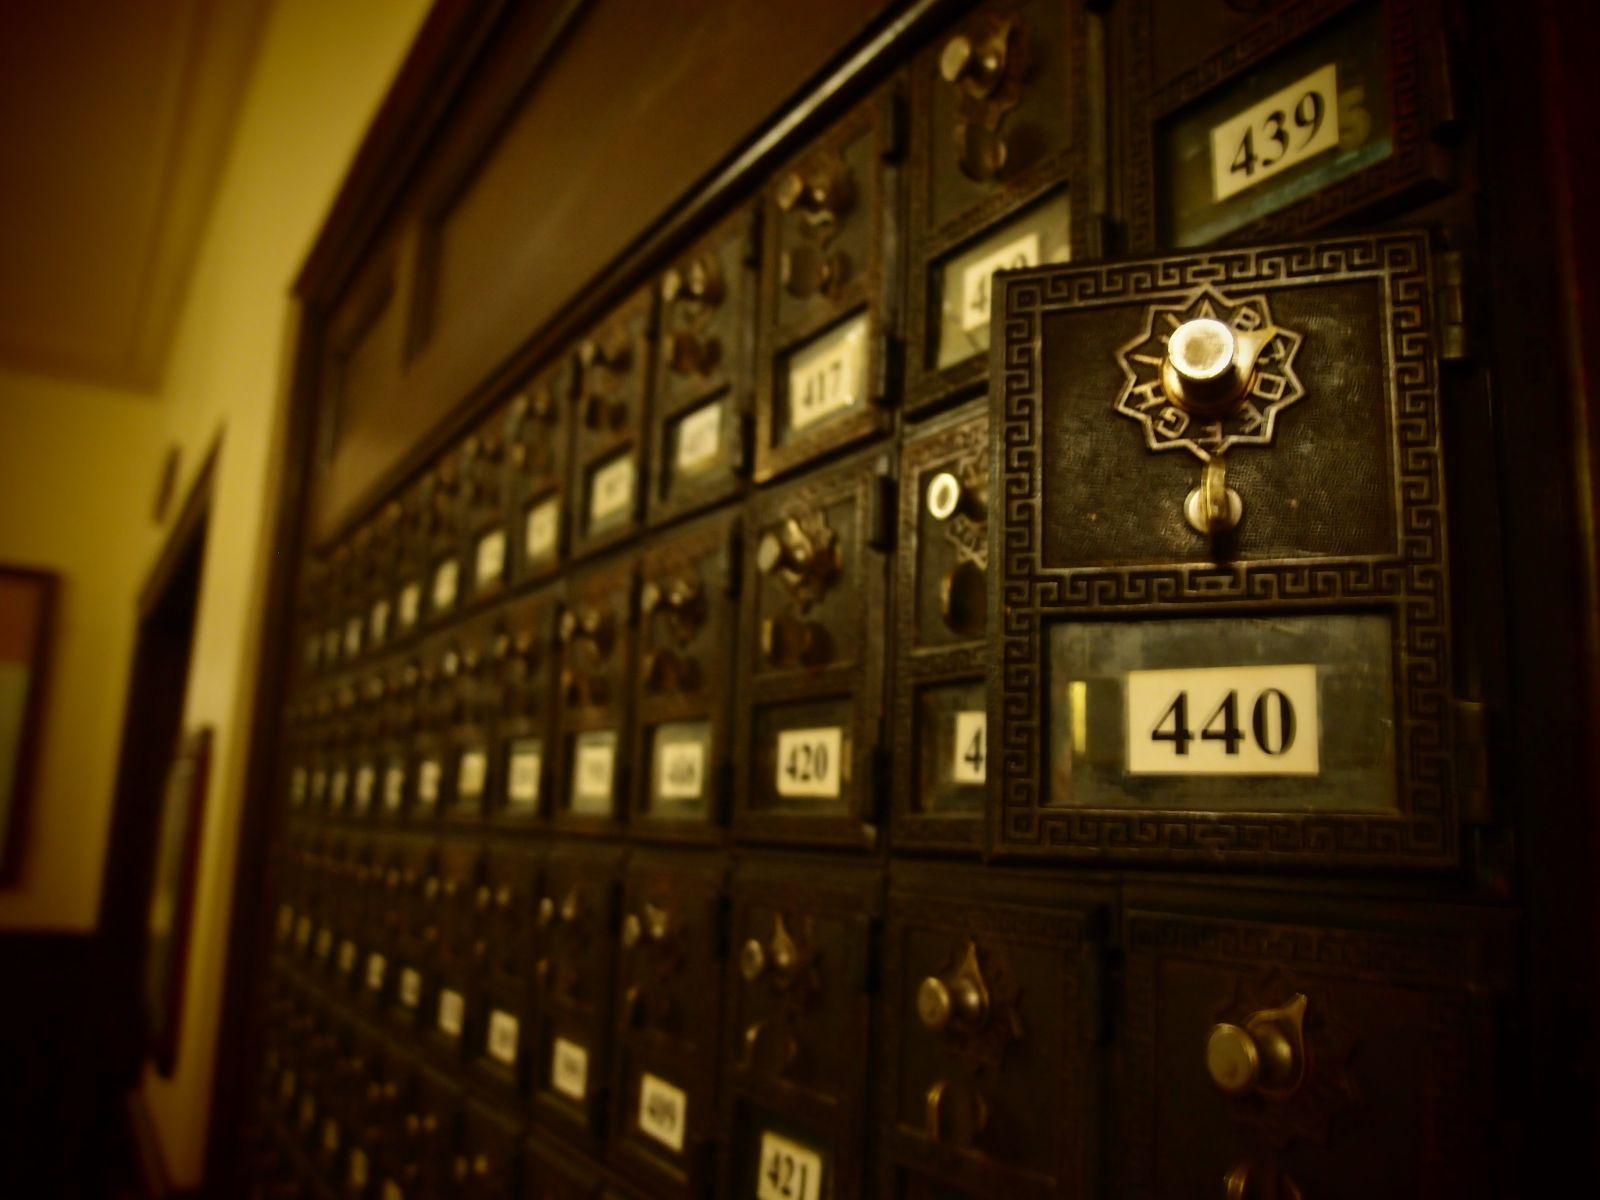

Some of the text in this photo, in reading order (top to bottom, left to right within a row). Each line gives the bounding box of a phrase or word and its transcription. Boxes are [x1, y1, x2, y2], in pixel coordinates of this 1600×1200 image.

[1229, 90, 1326, 177] 439
[1150, 687, 1298, 756] 440
[786, 742, 829, 782] 420
[767, 1150, 808, 1200] 421
